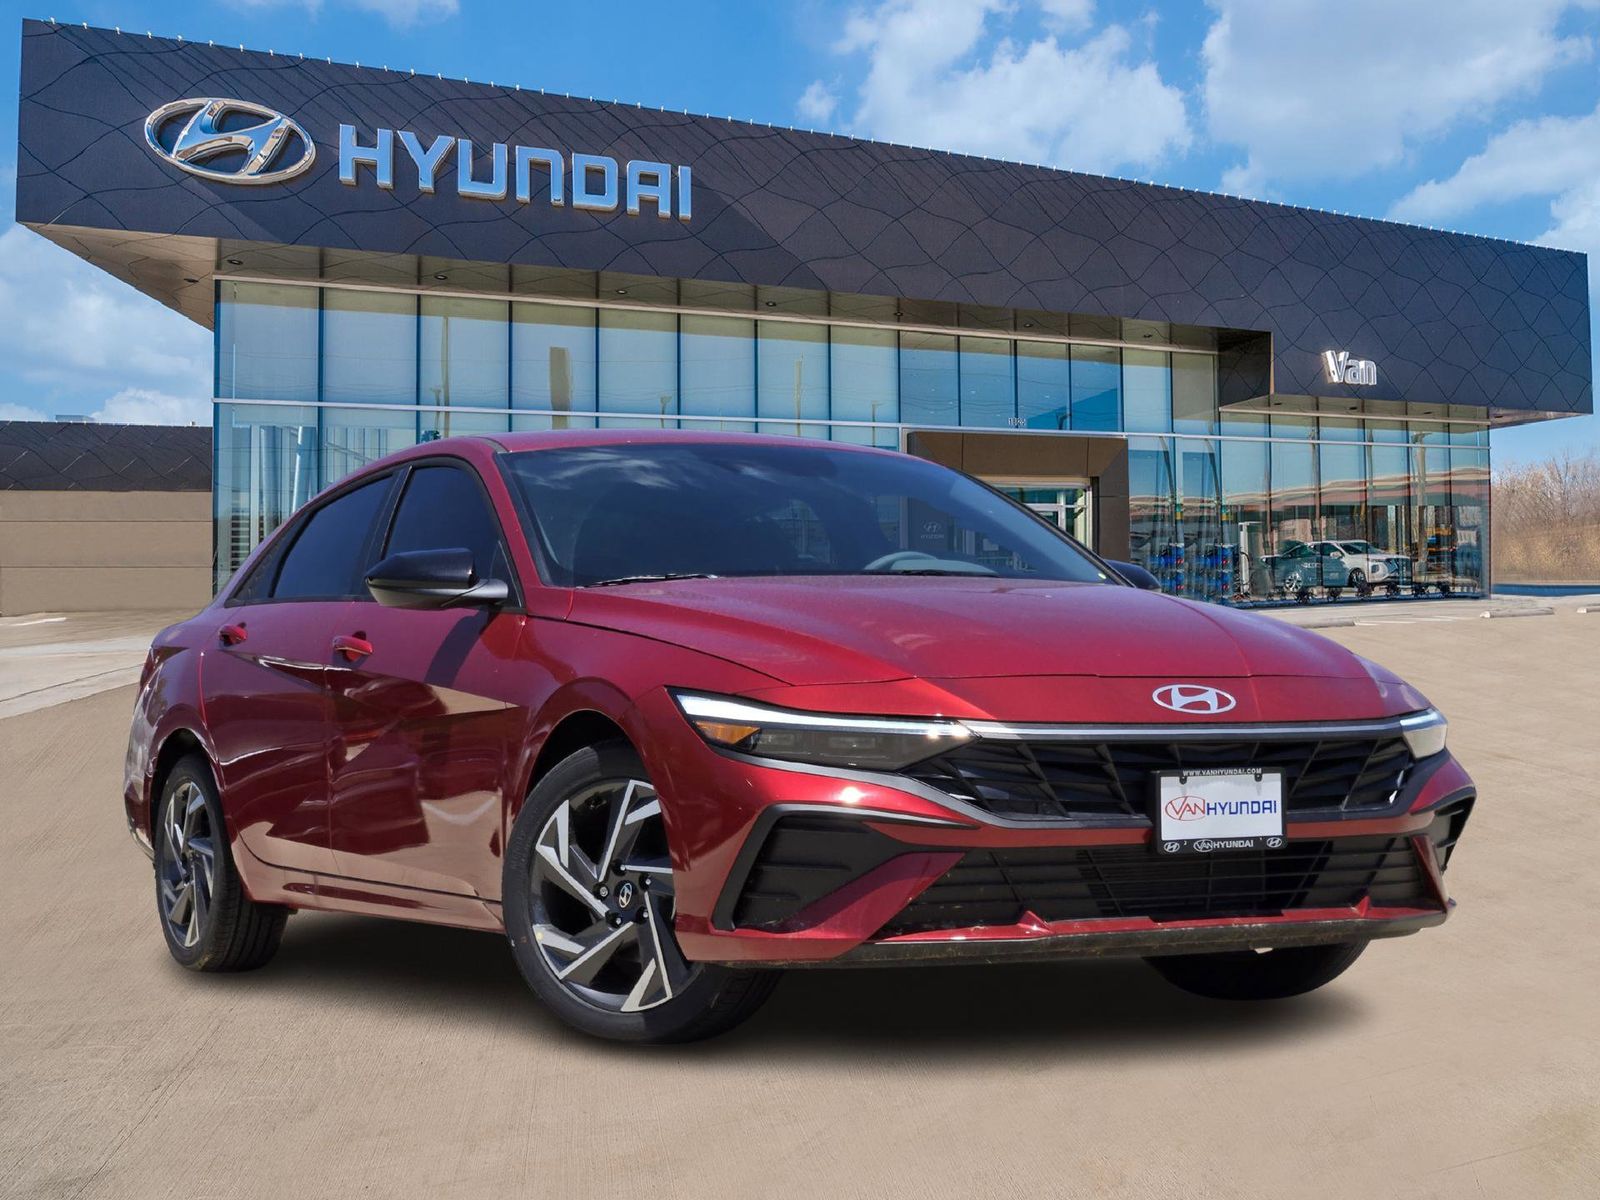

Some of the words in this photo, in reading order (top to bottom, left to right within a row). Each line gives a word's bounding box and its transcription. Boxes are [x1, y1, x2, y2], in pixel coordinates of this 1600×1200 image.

[339, 124, 692, 220] HYUNDAI
[1322, 350, 1377, 386] Van
[1182, 768, 1262, 776] WWW.VANHYUNDAI.COM
